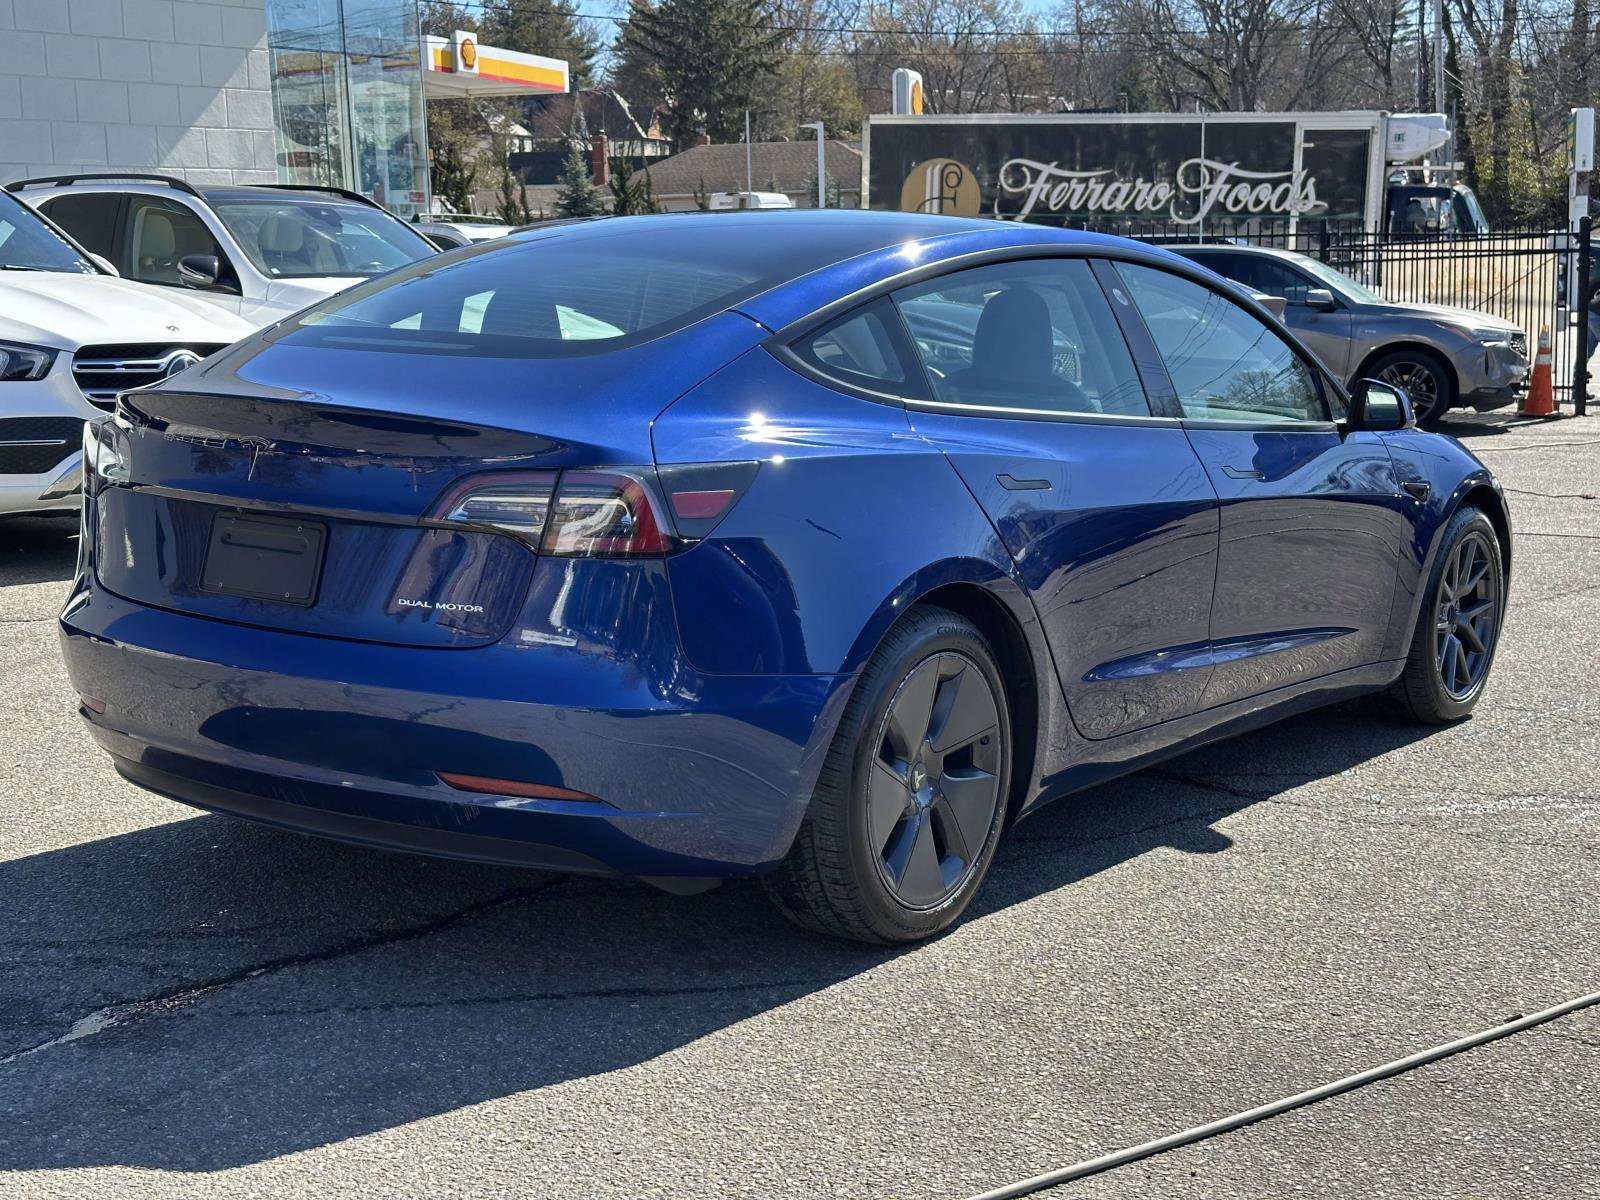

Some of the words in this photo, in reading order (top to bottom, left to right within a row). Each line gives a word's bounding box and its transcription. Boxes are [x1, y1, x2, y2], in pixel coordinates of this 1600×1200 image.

[993, 158, 1176, 222] Ferraro
[1169, 157, 1329, 225] Foods
[398, 598, 432, 608] DUAL
[435, 602, 484, 612] MOTOR
